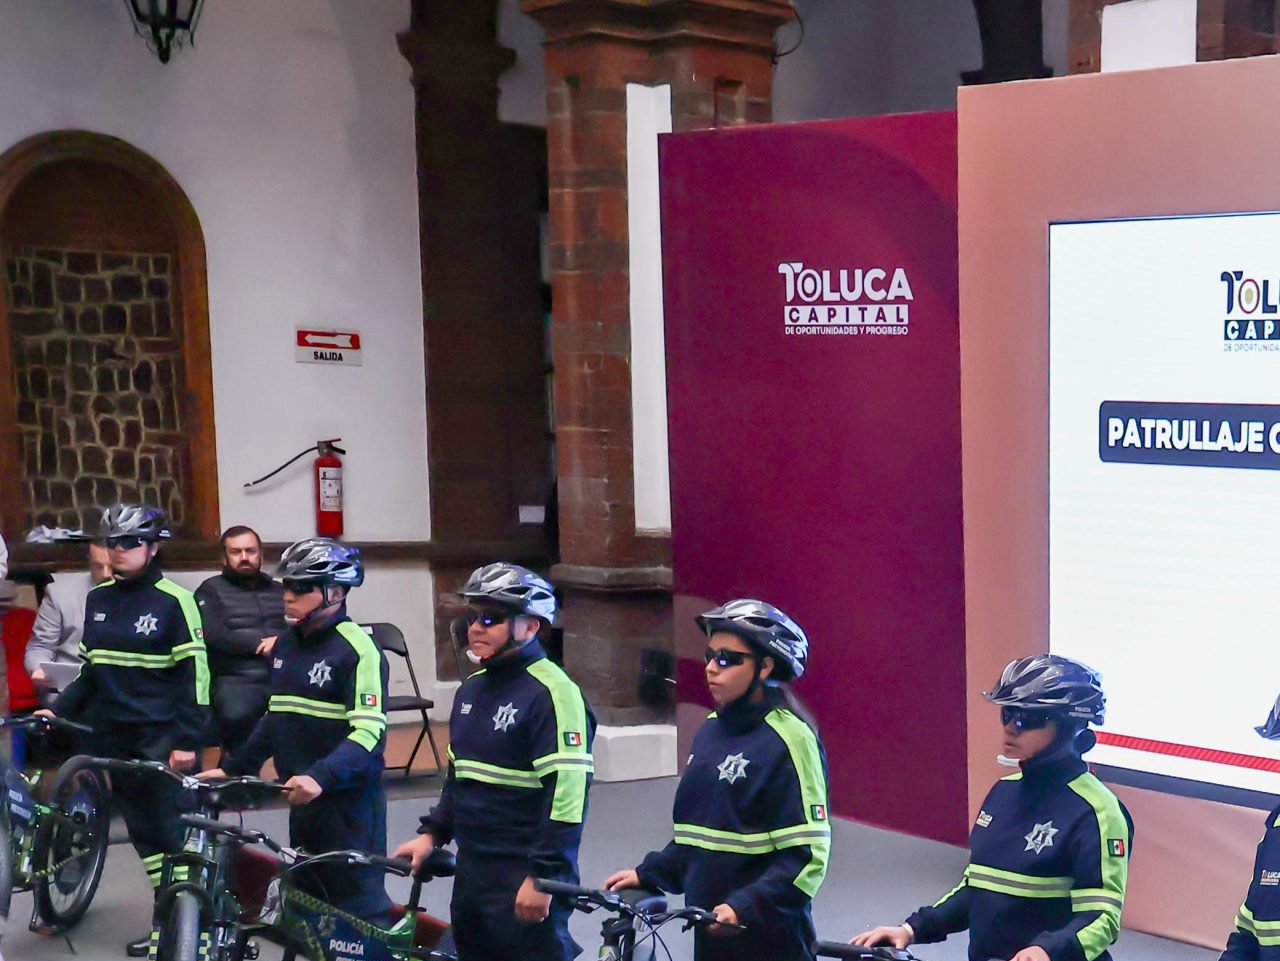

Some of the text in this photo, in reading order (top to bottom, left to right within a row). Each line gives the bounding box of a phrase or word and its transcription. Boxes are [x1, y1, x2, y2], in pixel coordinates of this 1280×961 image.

[778, 262, 913, 302] TOLUCA
[788, 307, 904, 323] CAPITAL
[785, 326, 909, 335] DE OPORTUNIDADES Y PROGRESO
[1224, 343, 1232, 351] DE
[313, 351, 343, 362] SALIDA
[1108, 417, 1264, 452] PATRULLAJE
[329, 939, 364, 956] POLICÍA
